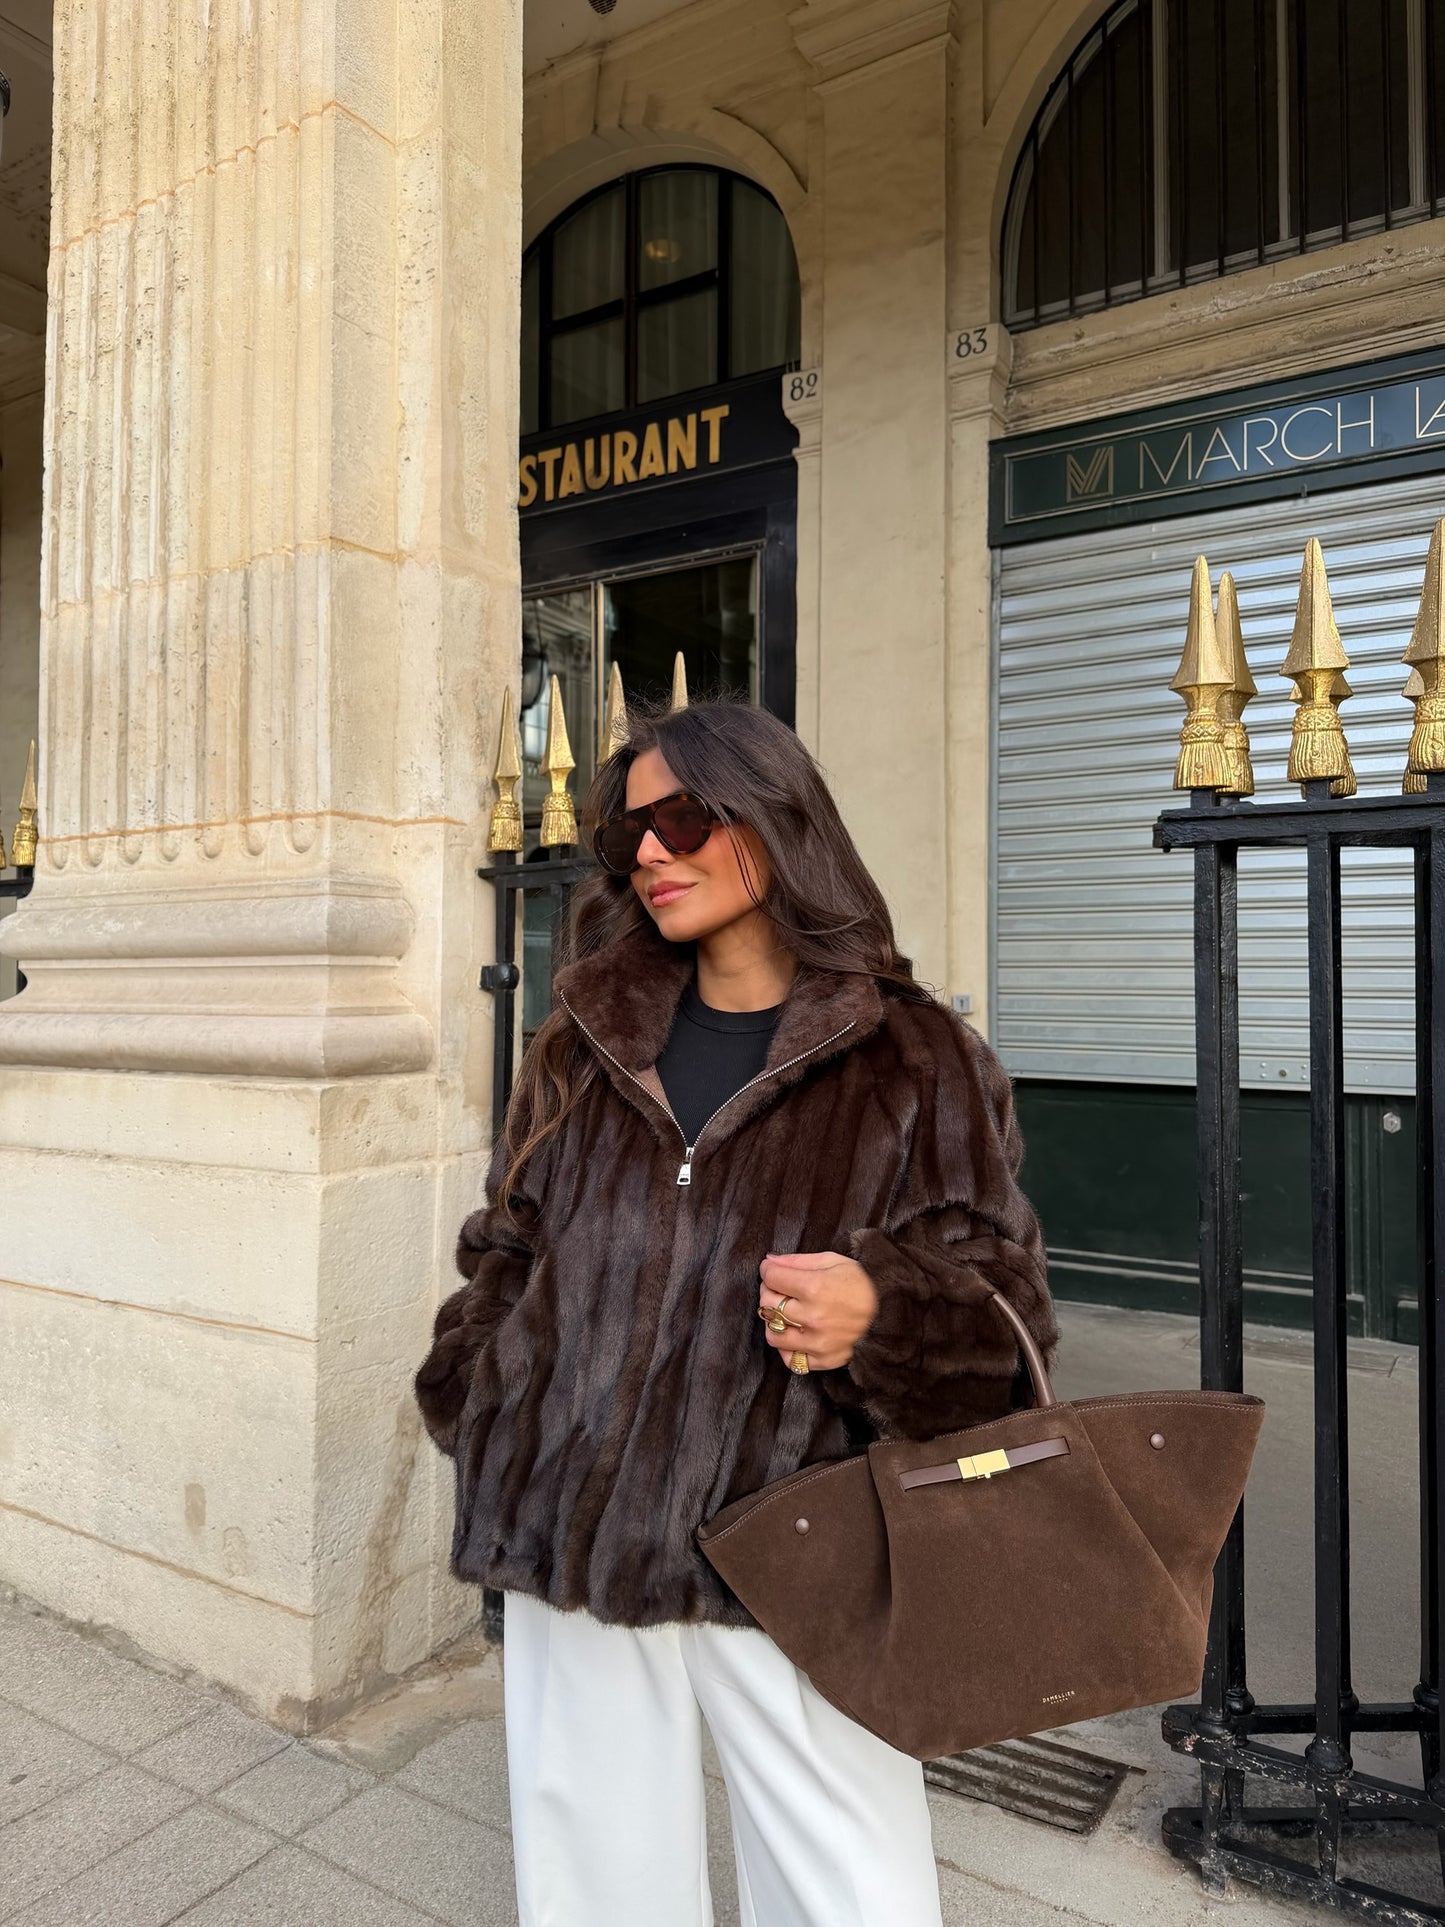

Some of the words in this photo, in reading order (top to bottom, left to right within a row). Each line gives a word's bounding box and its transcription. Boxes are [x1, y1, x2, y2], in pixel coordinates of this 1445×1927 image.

[956, 328, 987, 358] 83
[790, 373, 817, 401] 82
[1139, 396, 1374, 489] MARCH
